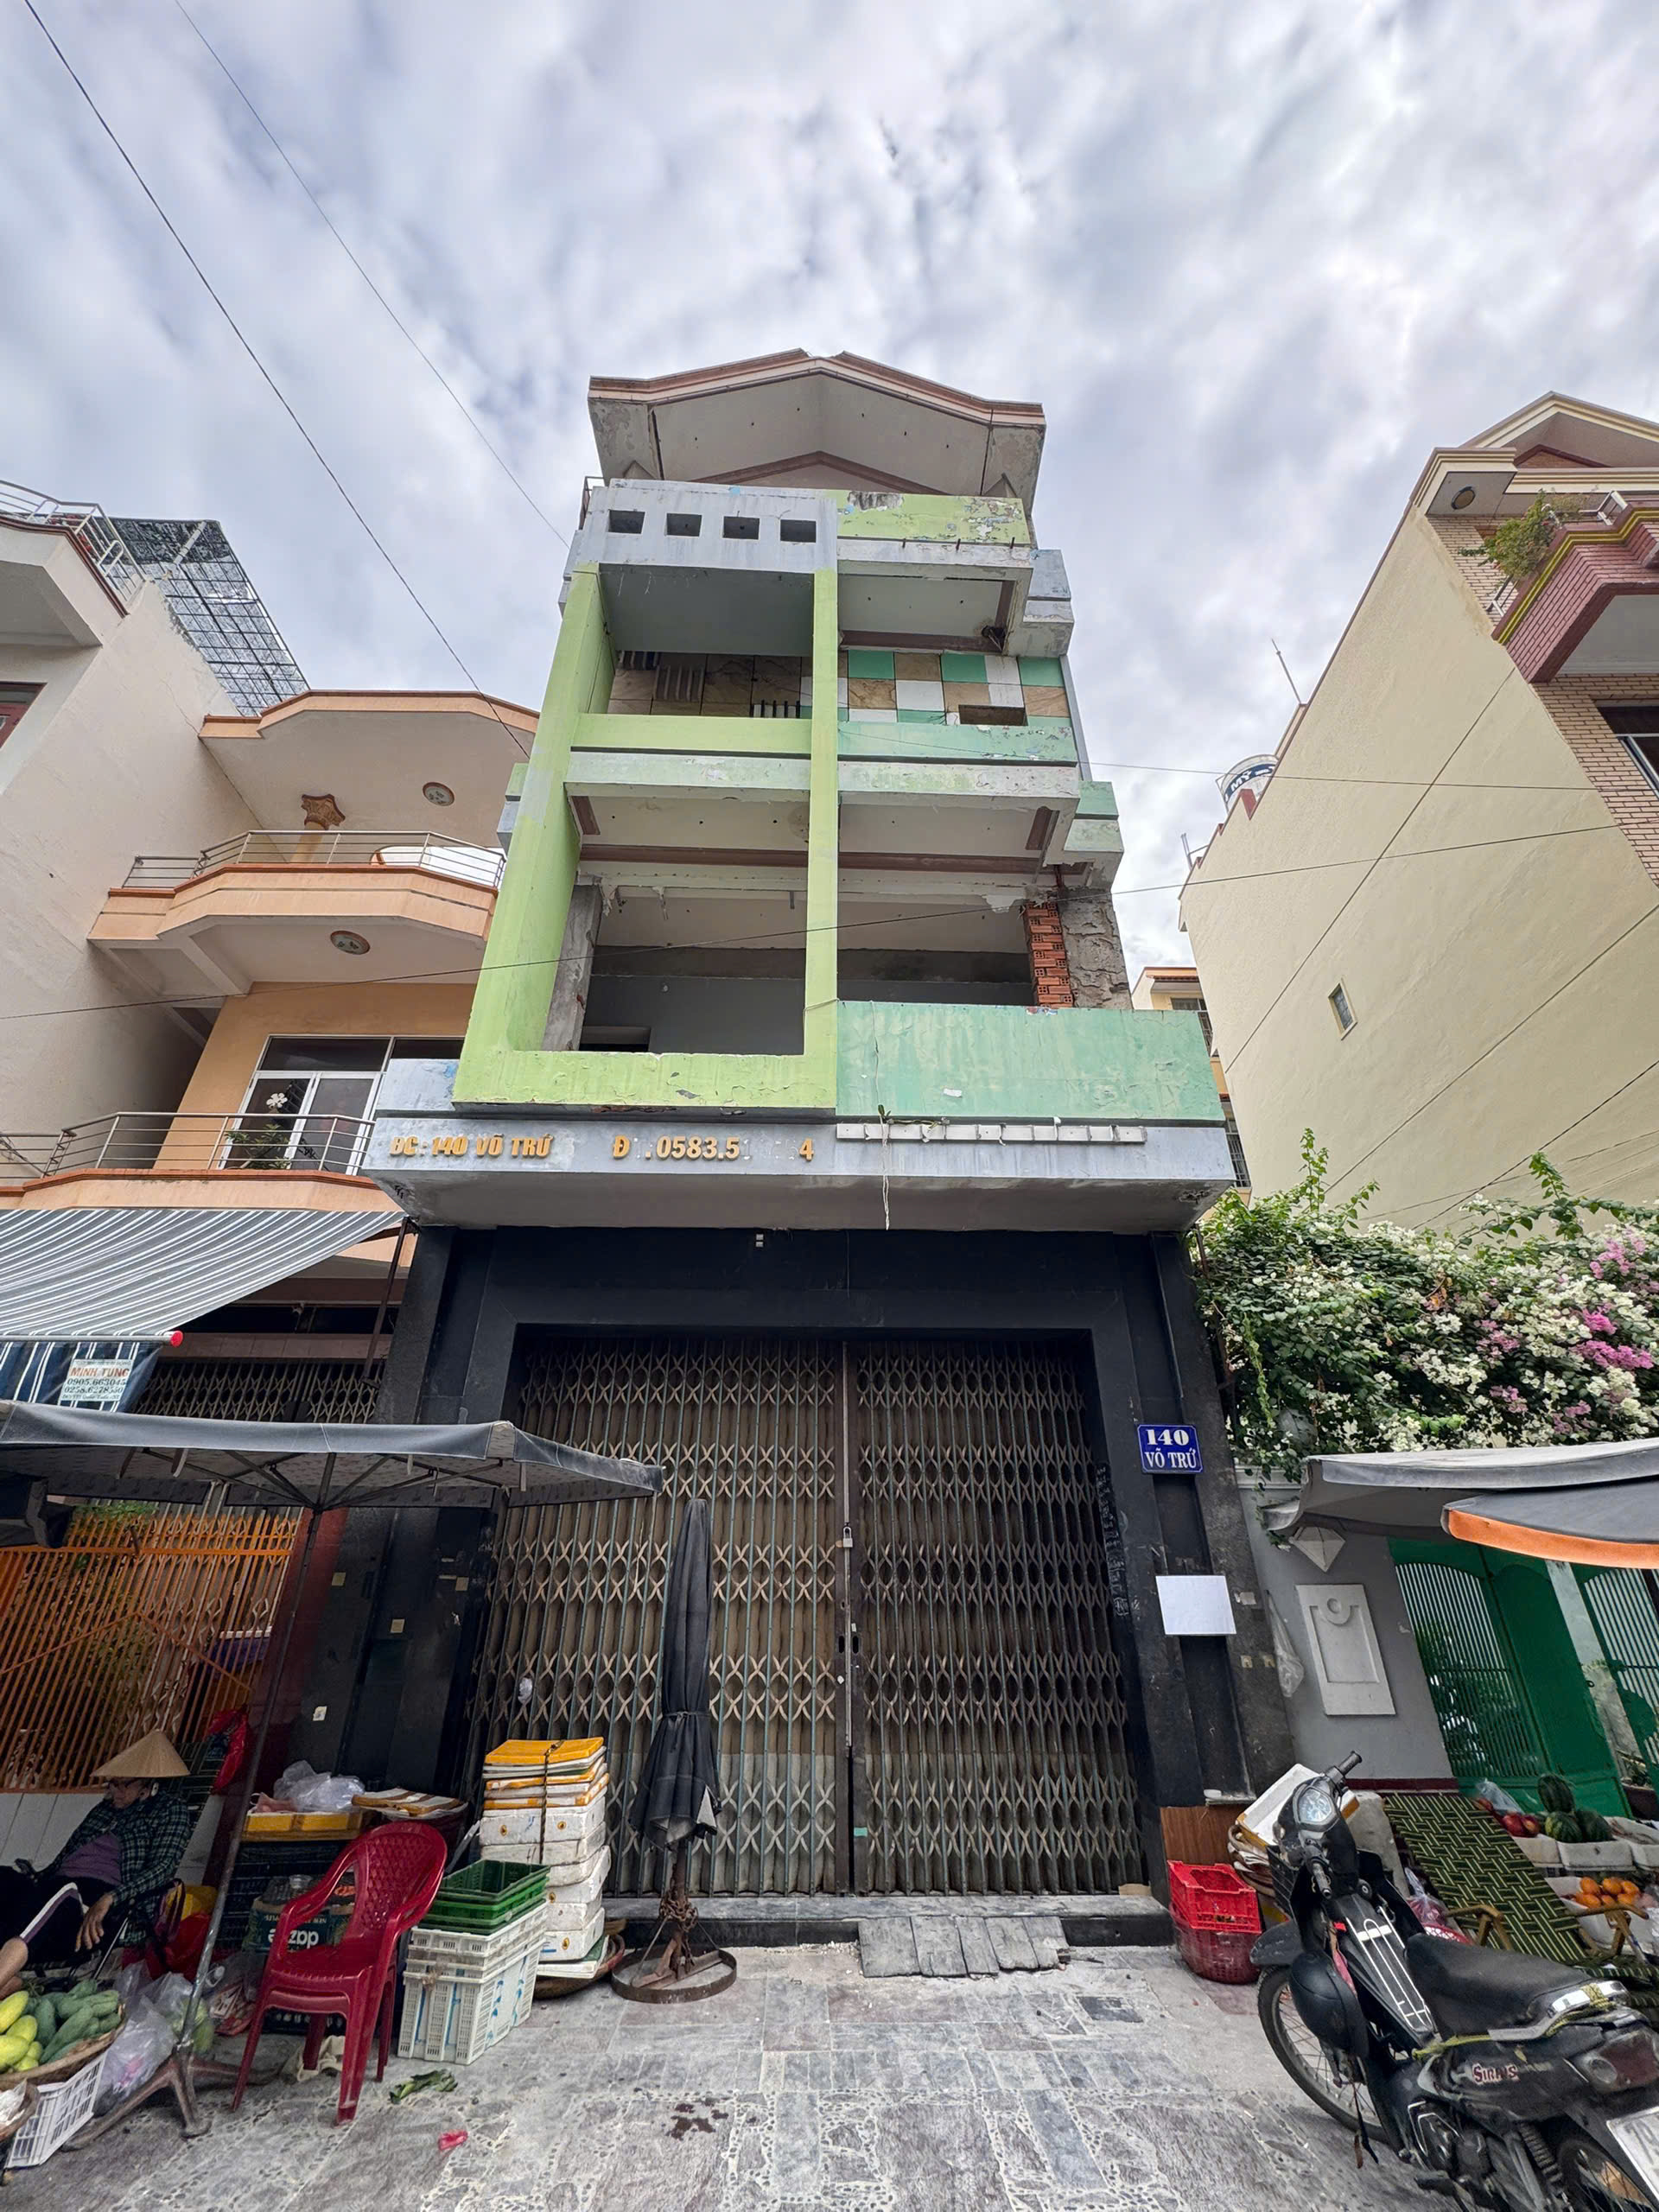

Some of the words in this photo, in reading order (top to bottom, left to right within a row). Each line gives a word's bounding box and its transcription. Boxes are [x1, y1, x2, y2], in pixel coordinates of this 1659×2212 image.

[431, 1135, 468, 1156] 140
[476, 1133, 504, 1157] VÕ
[512, 1133, 555, 1158] TRỨ
[70, 1367, 98, 1376] MINH
[1146, 1429, 1190, 1446] 140
[1144, 1447, 1166, 1468] VÕ
[1167, 1447, 1197, 1468] TRỨ
